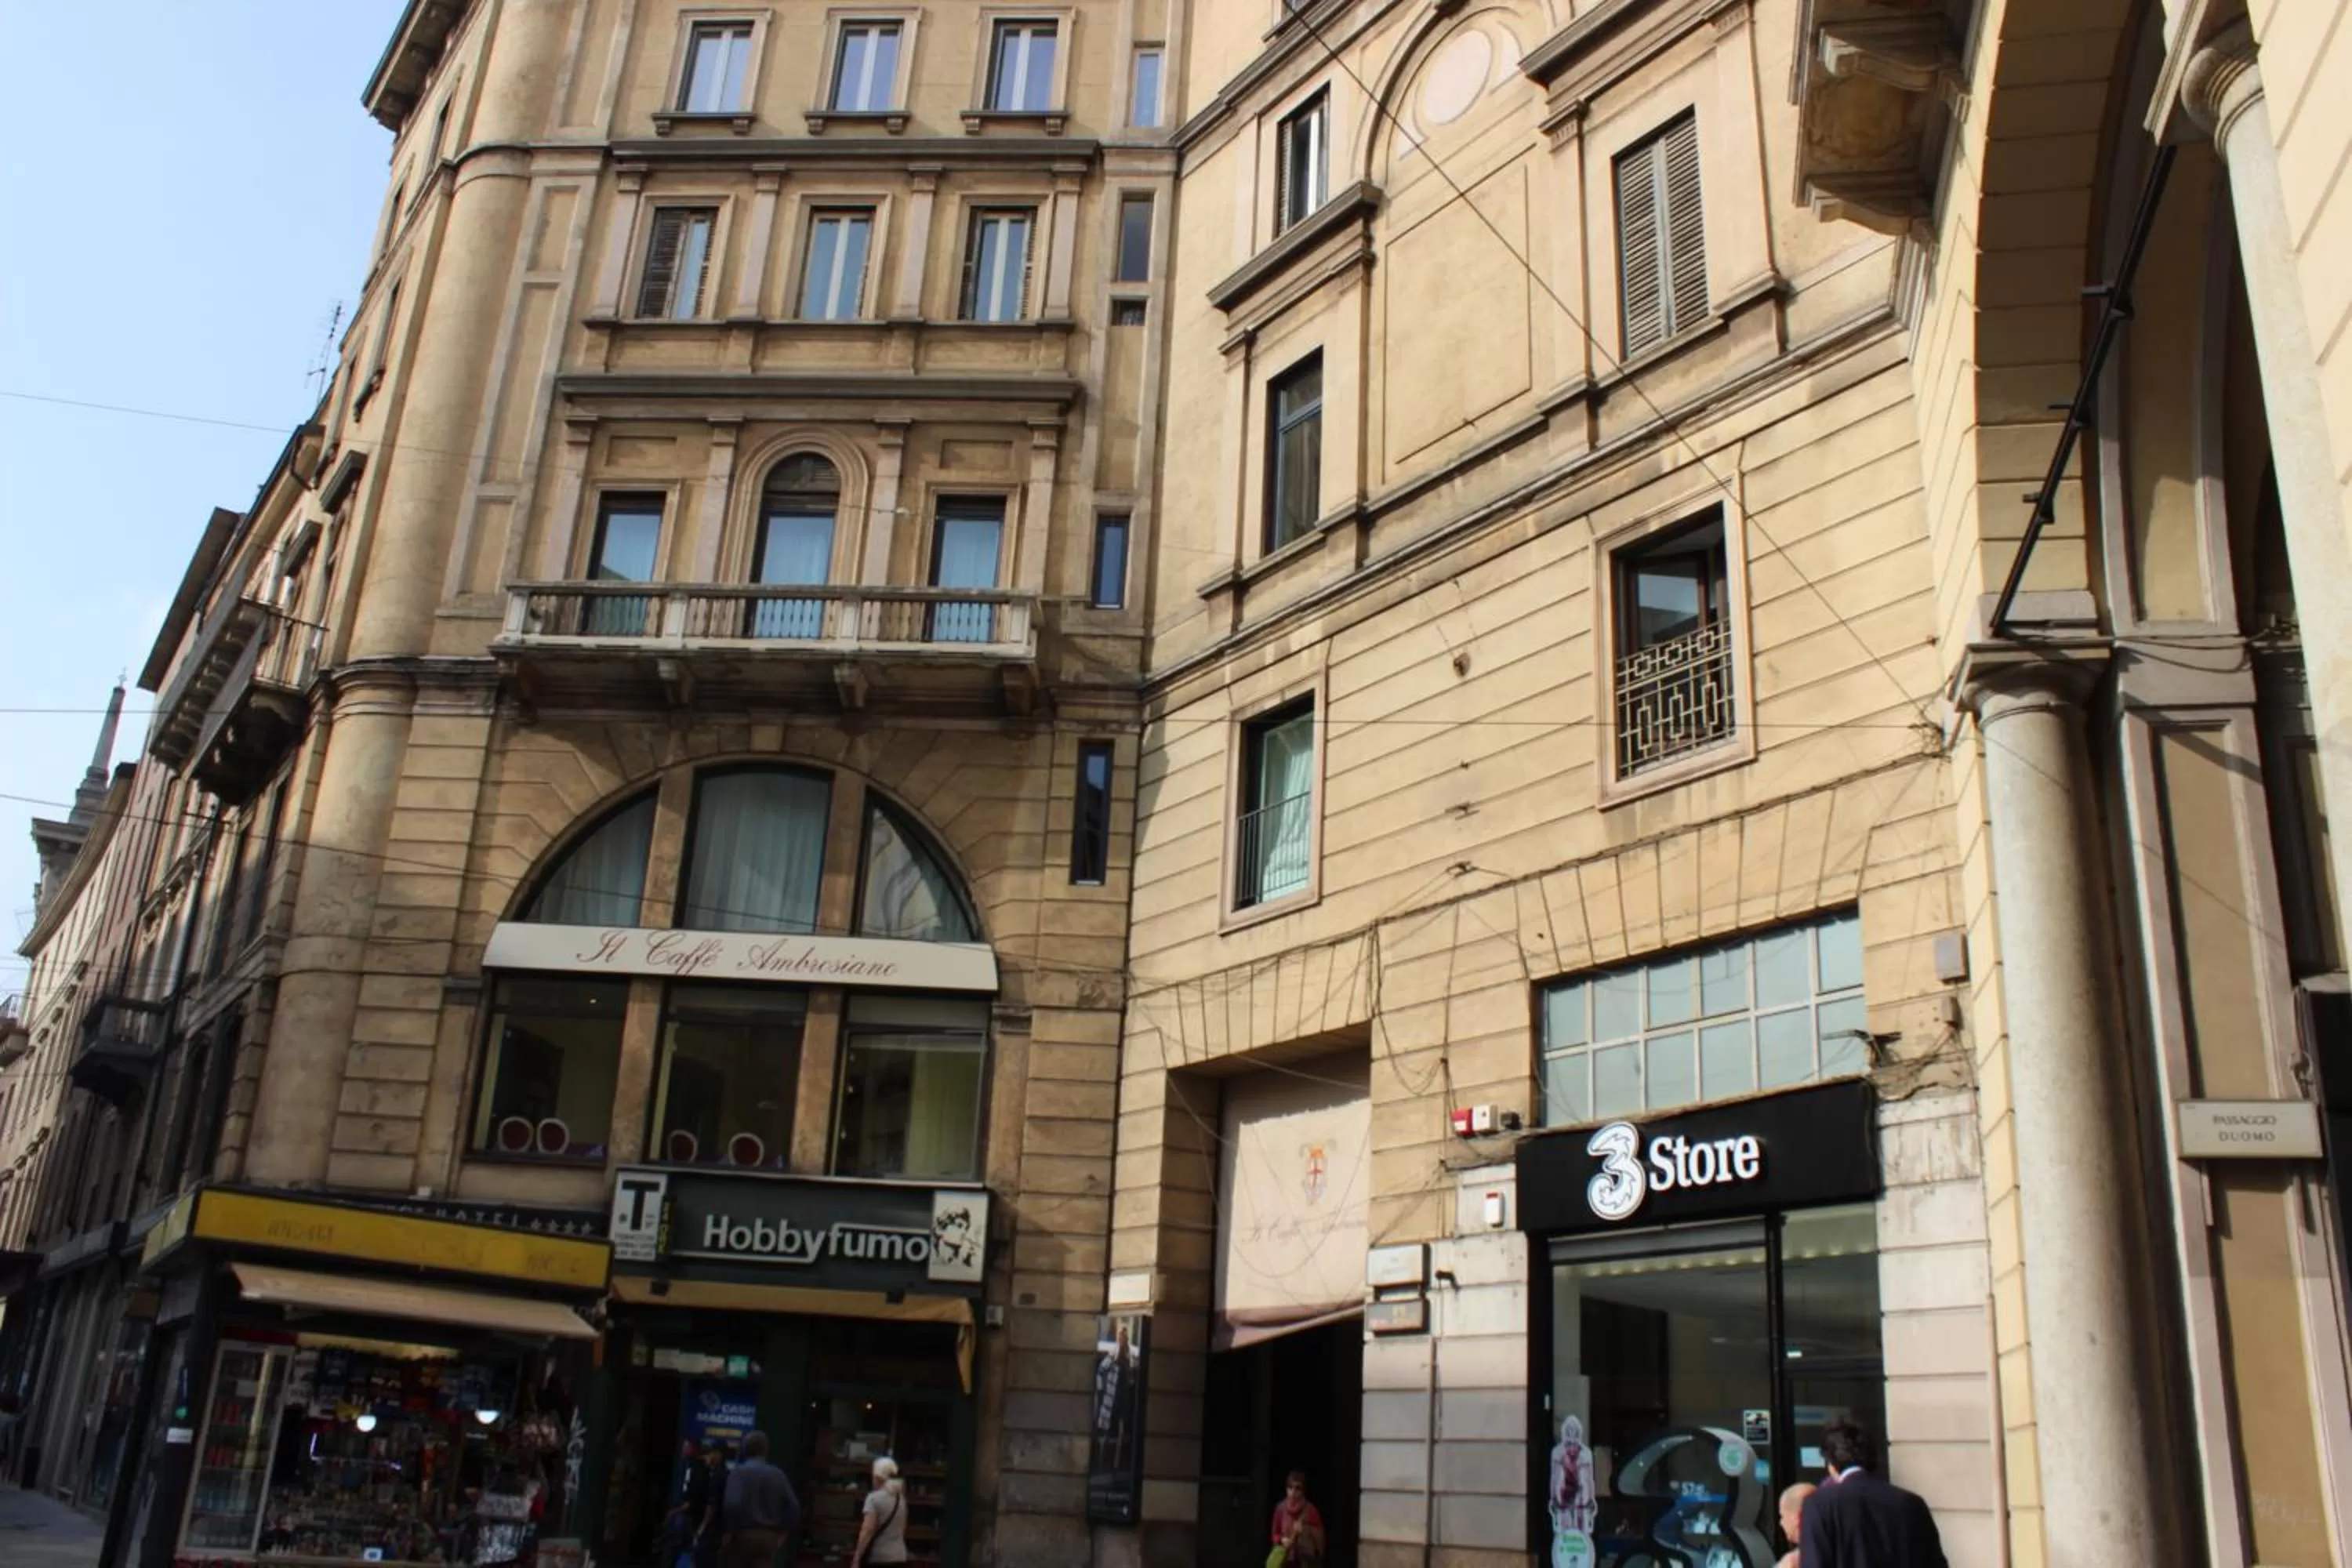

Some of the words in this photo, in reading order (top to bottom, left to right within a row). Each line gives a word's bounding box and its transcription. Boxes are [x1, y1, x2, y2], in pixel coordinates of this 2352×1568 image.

[576, 930, 627, 964] Il
[736, 938, 898, 977] Ambrosiano
[2212, 1114, 2278, 1126] PASSAGGIO
[2218, 1131, 2276, 1142] DUOMO
[1649, 1134, 1761, 1192] Store
[621, 1180, 660, 1231] T
[720, 1404, 756, 1414] CASH
[695, 1412, 755, 1426] MACHINE
